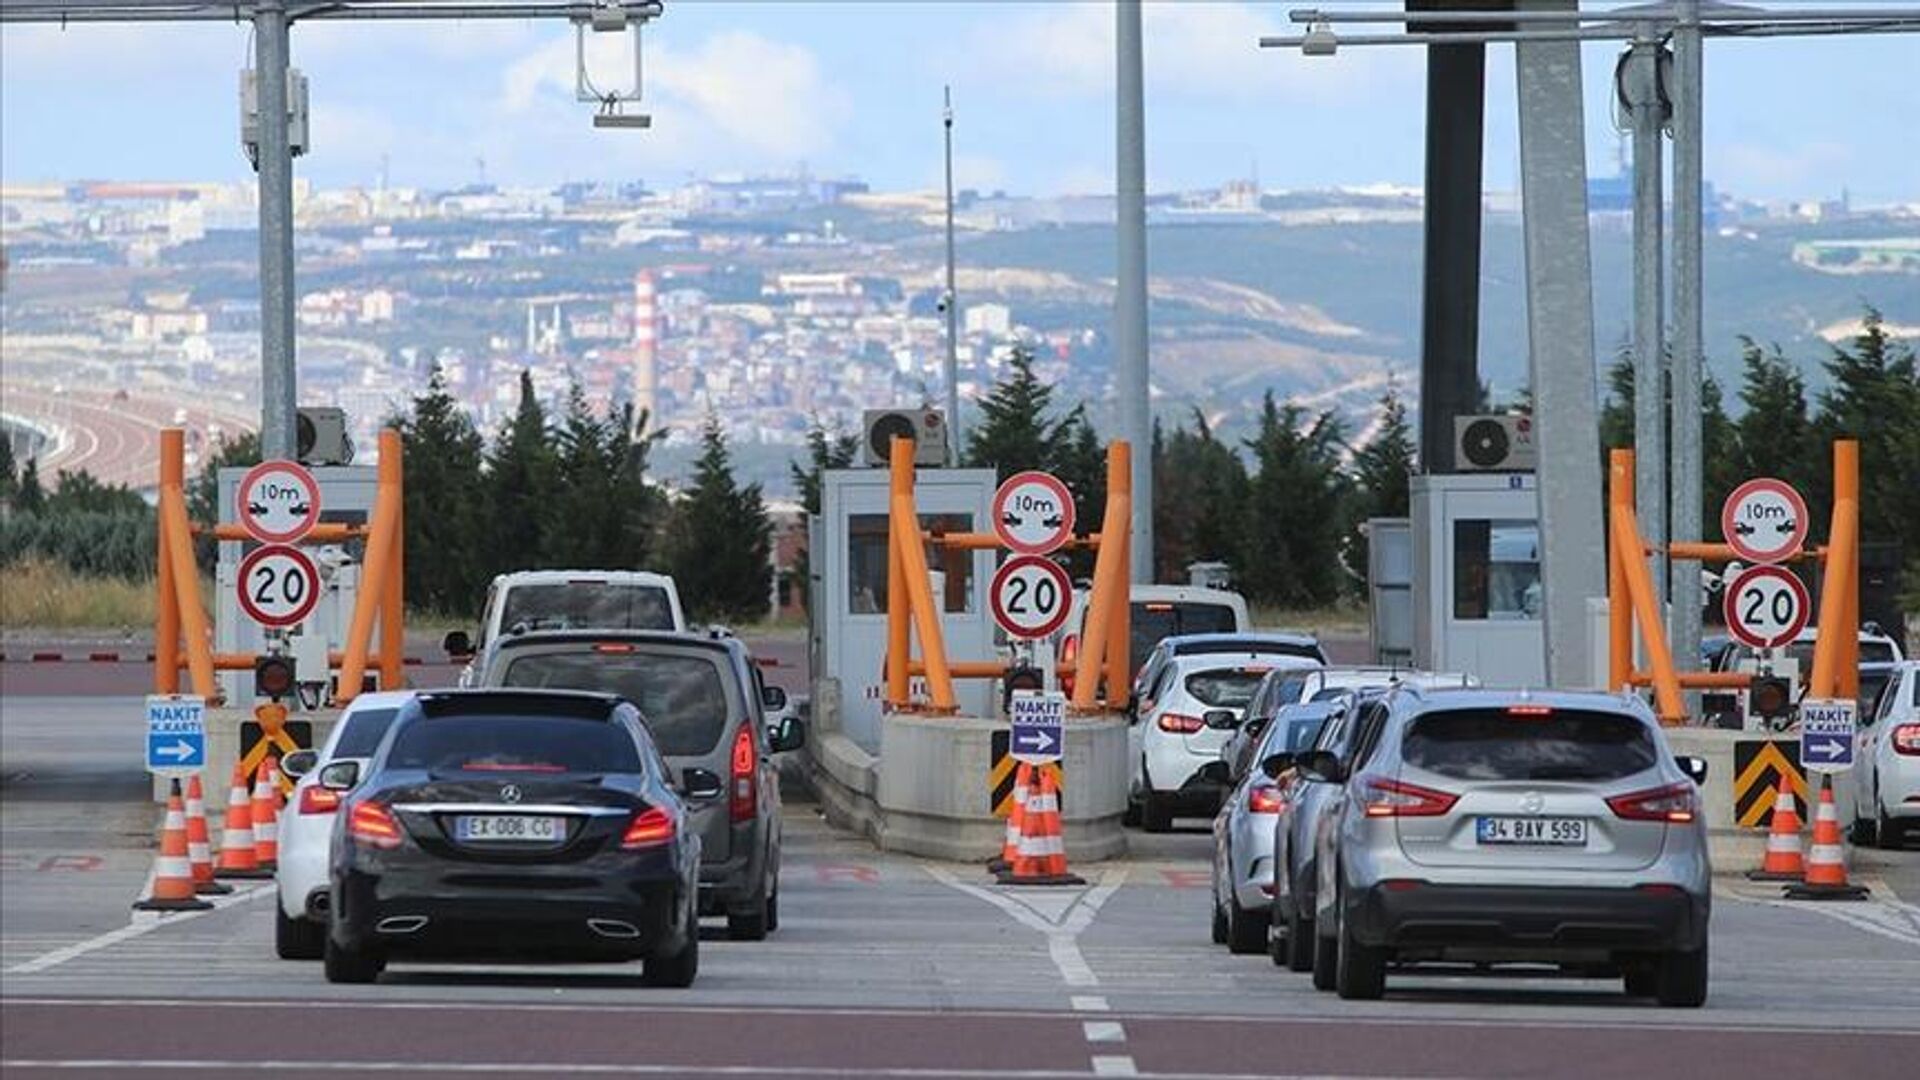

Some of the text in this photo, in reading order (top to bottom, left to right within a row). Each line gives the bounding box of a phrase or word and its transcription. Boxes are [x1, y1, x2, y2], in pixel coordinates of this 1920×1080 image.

[261, 484, 299, 499] 10m
[1015, 496, 1054, 511] 10m
[1746, 504, 1785, 519] 10m
[255, 566, 304, 603] 20
[1007, 577, 1055, 614] 20
[1744, 588, 1793, 625] 20
[1487, 820, 1507, 836] 34
[1551, 821, 1581, 838] 599
